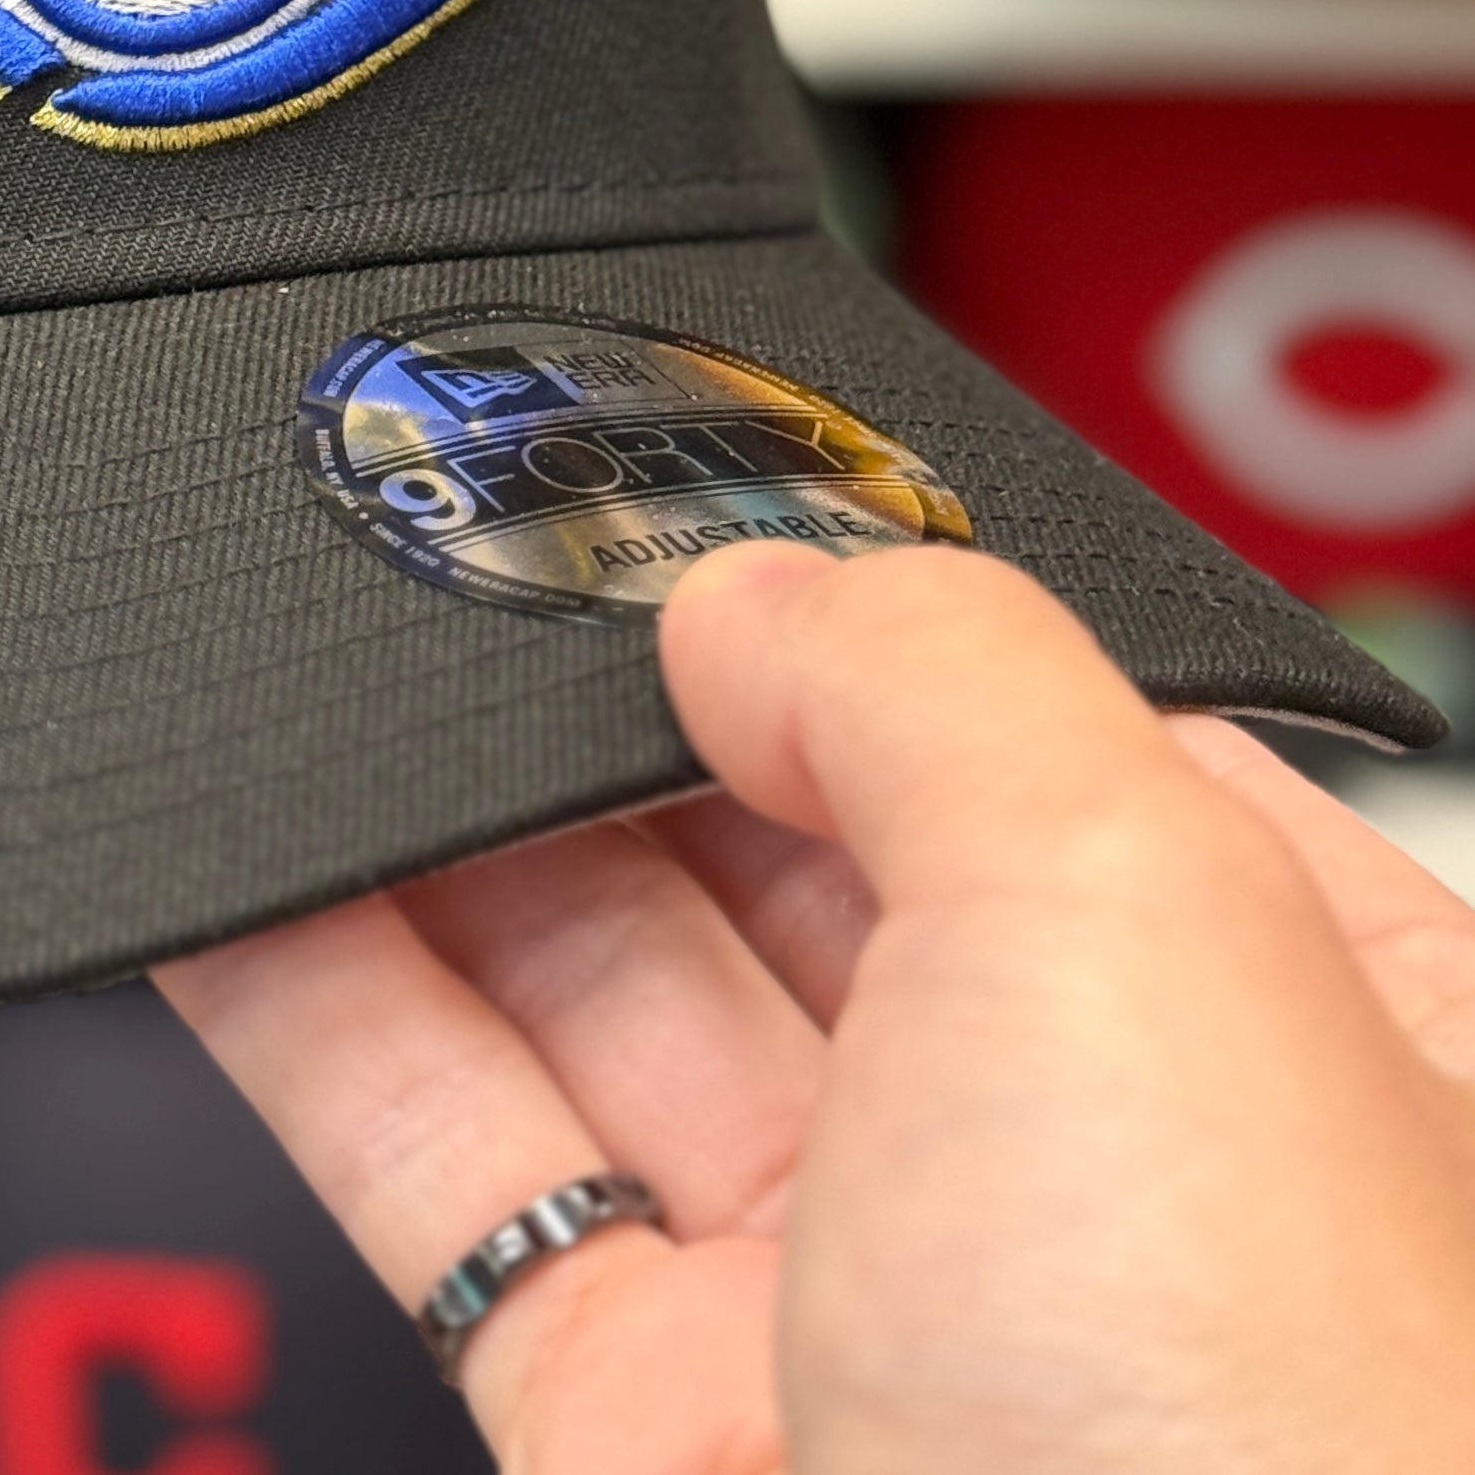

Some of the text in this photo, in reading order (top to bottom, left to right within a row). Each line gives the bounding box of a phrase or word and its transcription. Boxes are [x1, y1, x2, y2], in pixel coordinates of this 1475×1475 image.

[543, 351, 635, 373] NEW
[567, 367, 658, 390] ERA
[379, 420, 845, 531] 9FORTY
[590, 512, 872, 573] ADJUSTABLE
